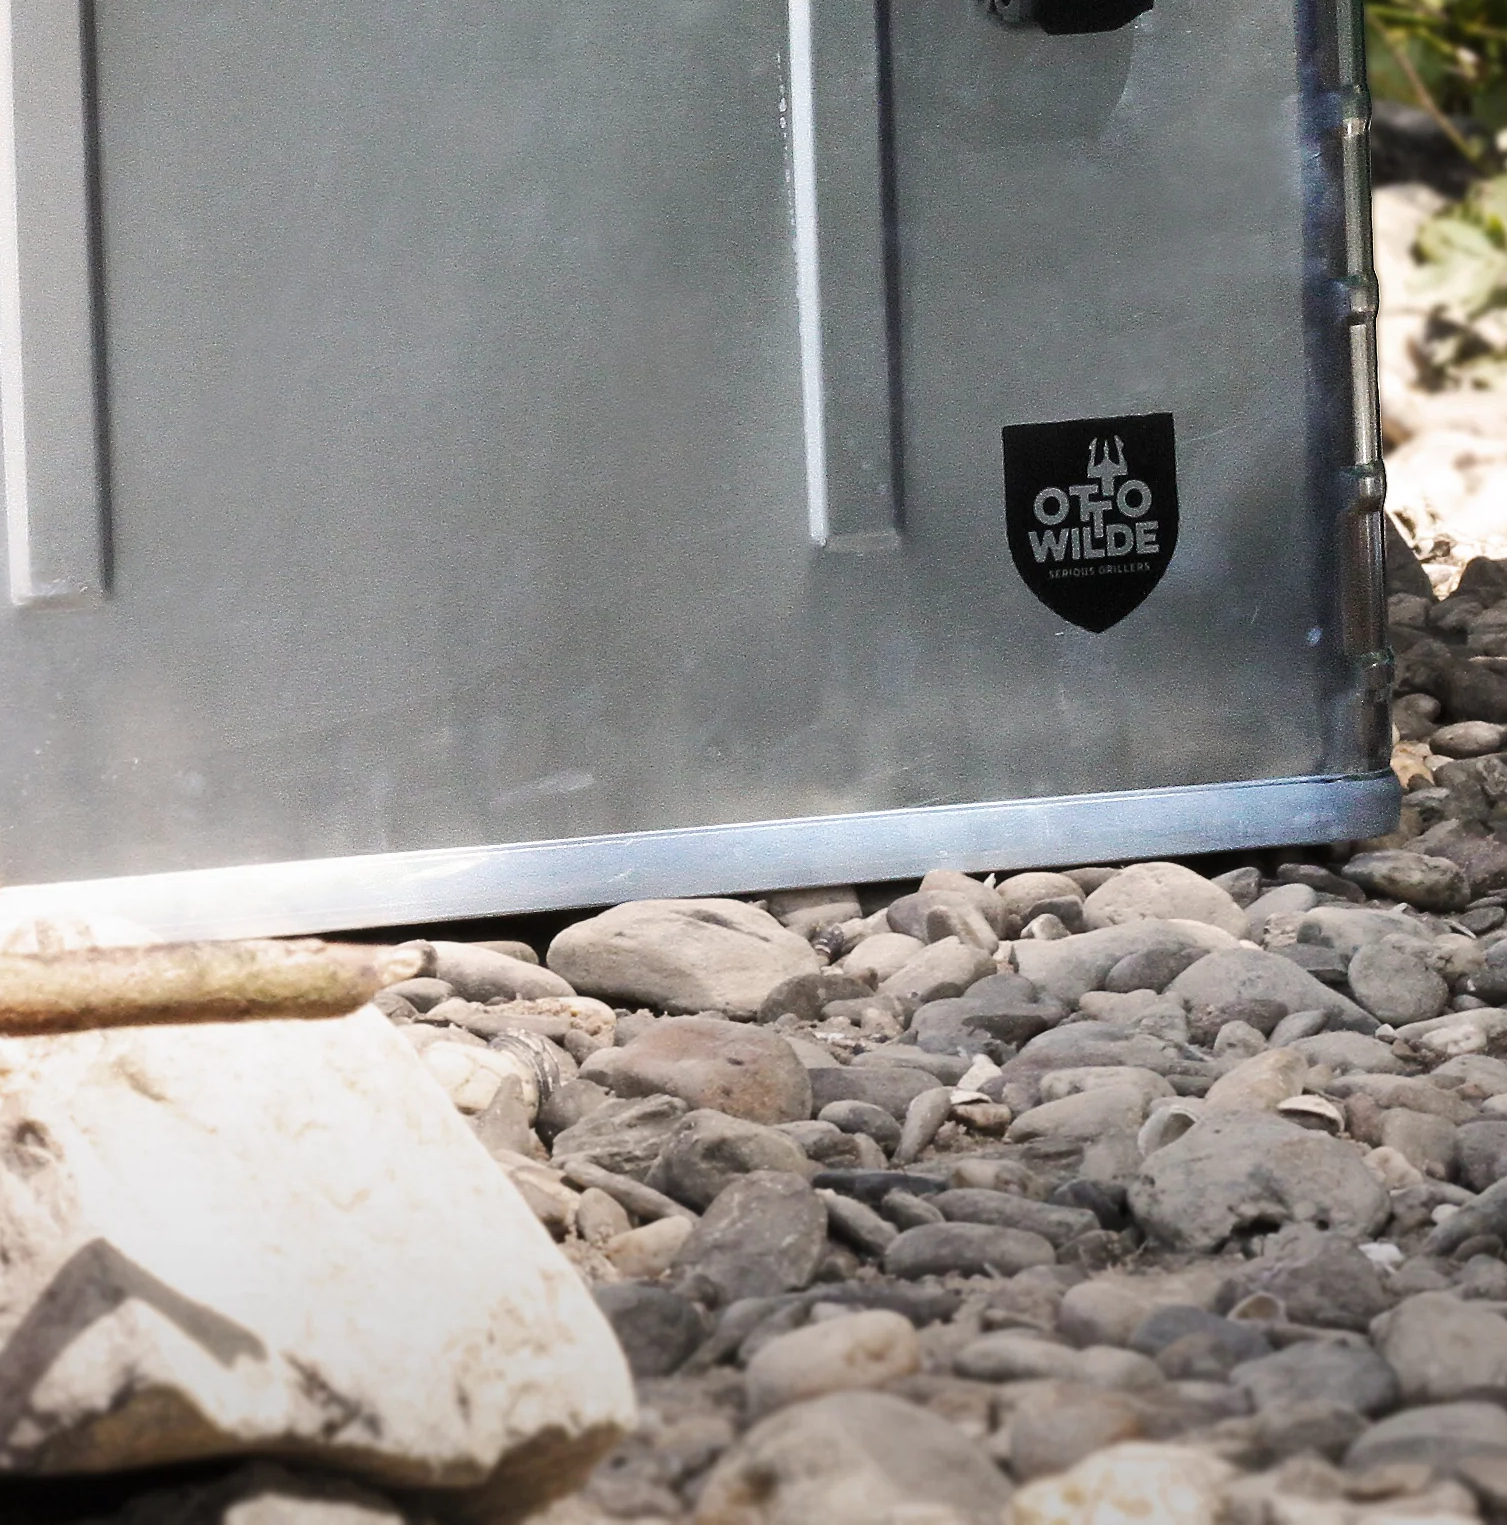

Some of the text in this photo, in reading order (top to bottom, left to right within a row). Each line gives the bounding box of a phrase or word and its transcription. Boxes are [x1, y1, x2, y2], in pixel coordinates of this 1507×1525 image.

[1033, 479, 1152, 538] OTTO
[1028, 521, 1160, 563] WILDE
[1049, 562, 1151, 579] SERIOUS GRILLERS
